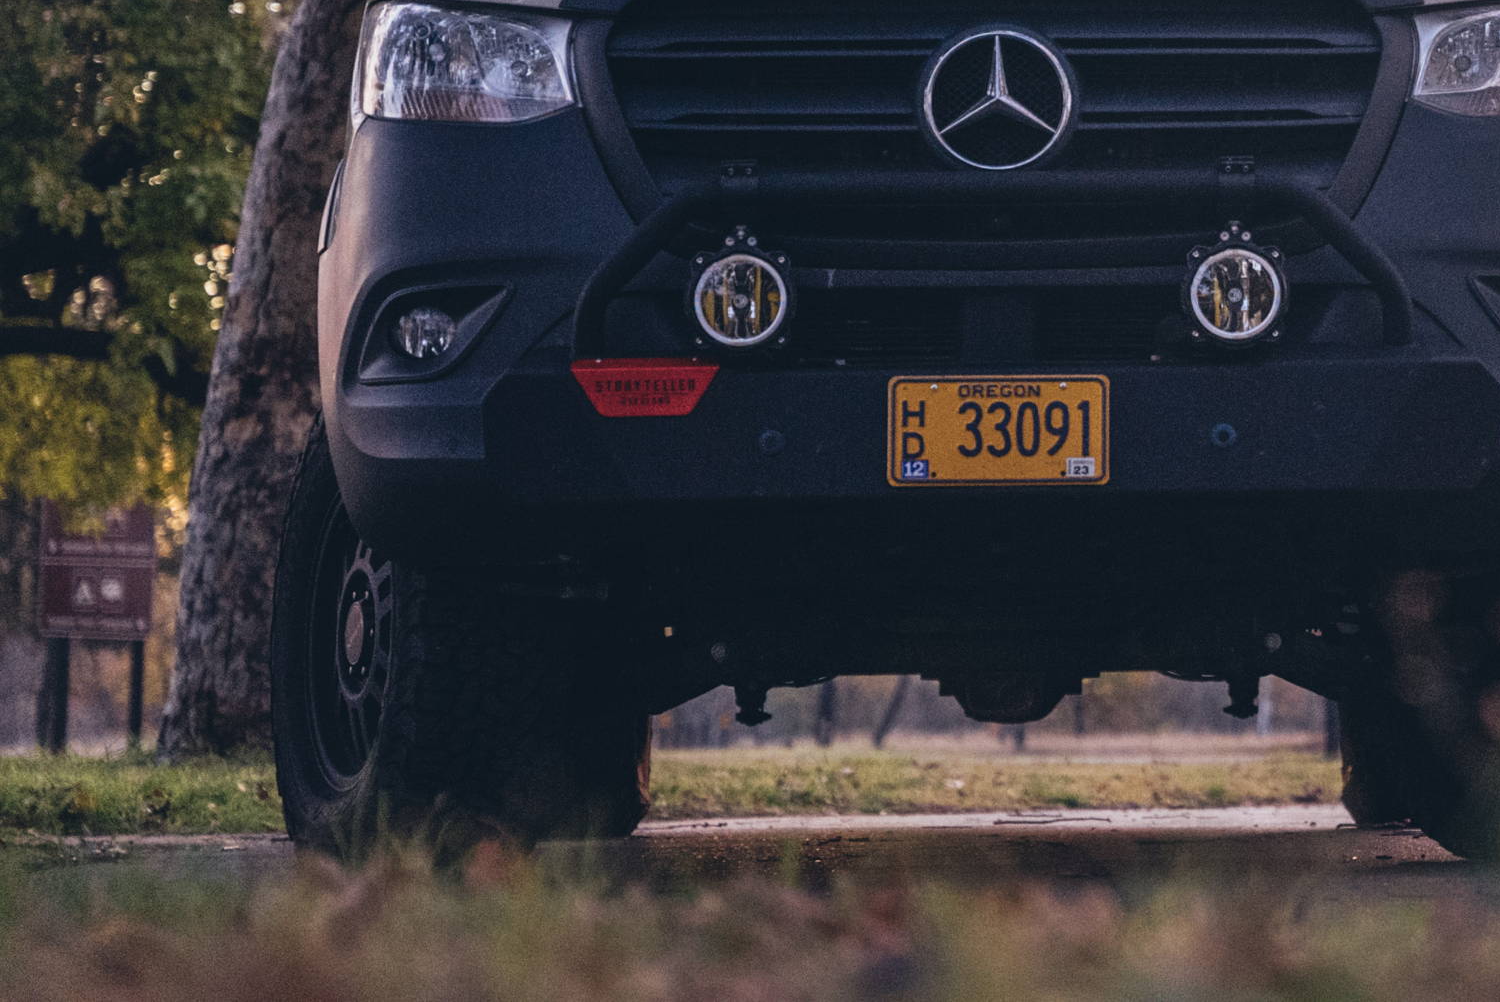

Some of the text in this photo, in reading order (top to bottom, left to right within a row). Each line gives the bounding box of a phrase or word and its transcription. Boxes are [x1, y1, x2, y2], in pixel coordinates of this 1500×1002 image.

[957, 384, 1041, 399] OREGON
[957, 400, 1091, 458] 33091
[904, 460, 926, 478] 12
[1073, 465, 1090, 476] 23
